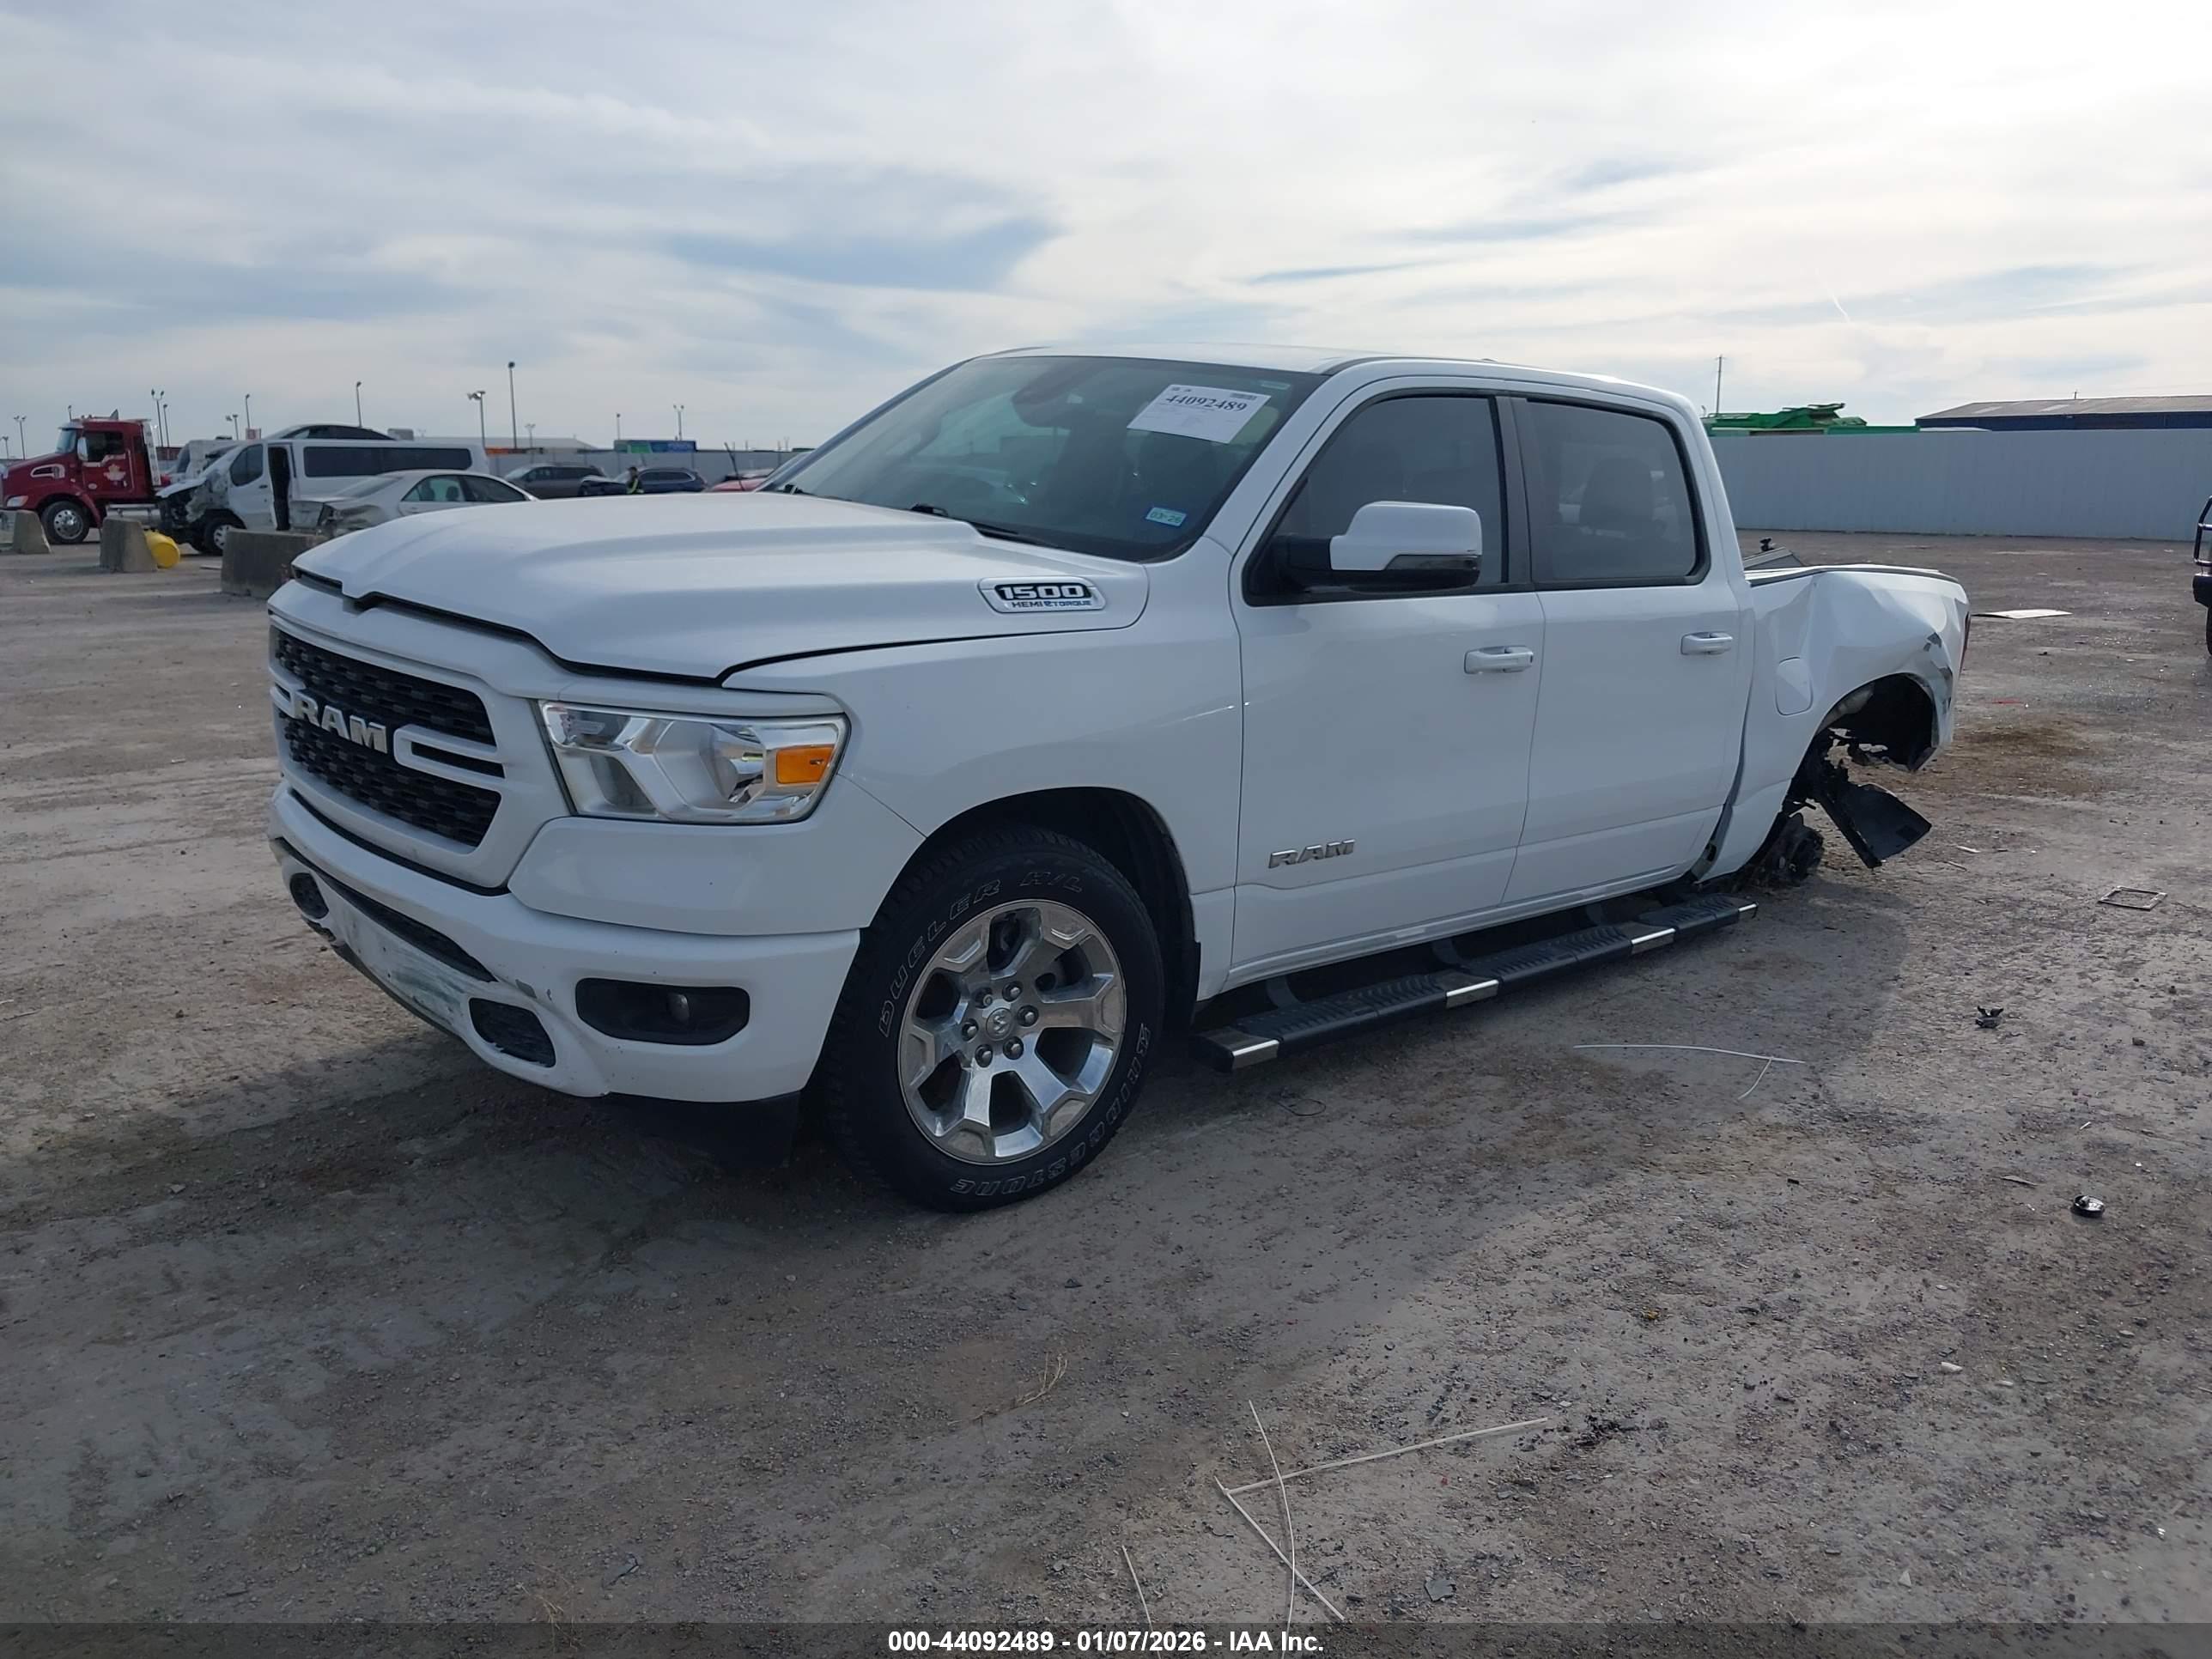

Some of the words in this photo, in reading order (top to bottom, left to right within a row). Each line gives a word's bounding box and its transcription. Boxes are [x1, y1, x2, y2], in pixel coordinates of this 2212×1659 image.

[1166, 395, 1248, 412] 44092489
[1000, 585, 1085, 600] 1500
[294, 690, 388, 753] RAM
[1268, 839, 1356, 869] RAM
[878, 879, 1003, 1038] DUELER
[951, 1024, 1152, 1196] BRIDGESTONE
